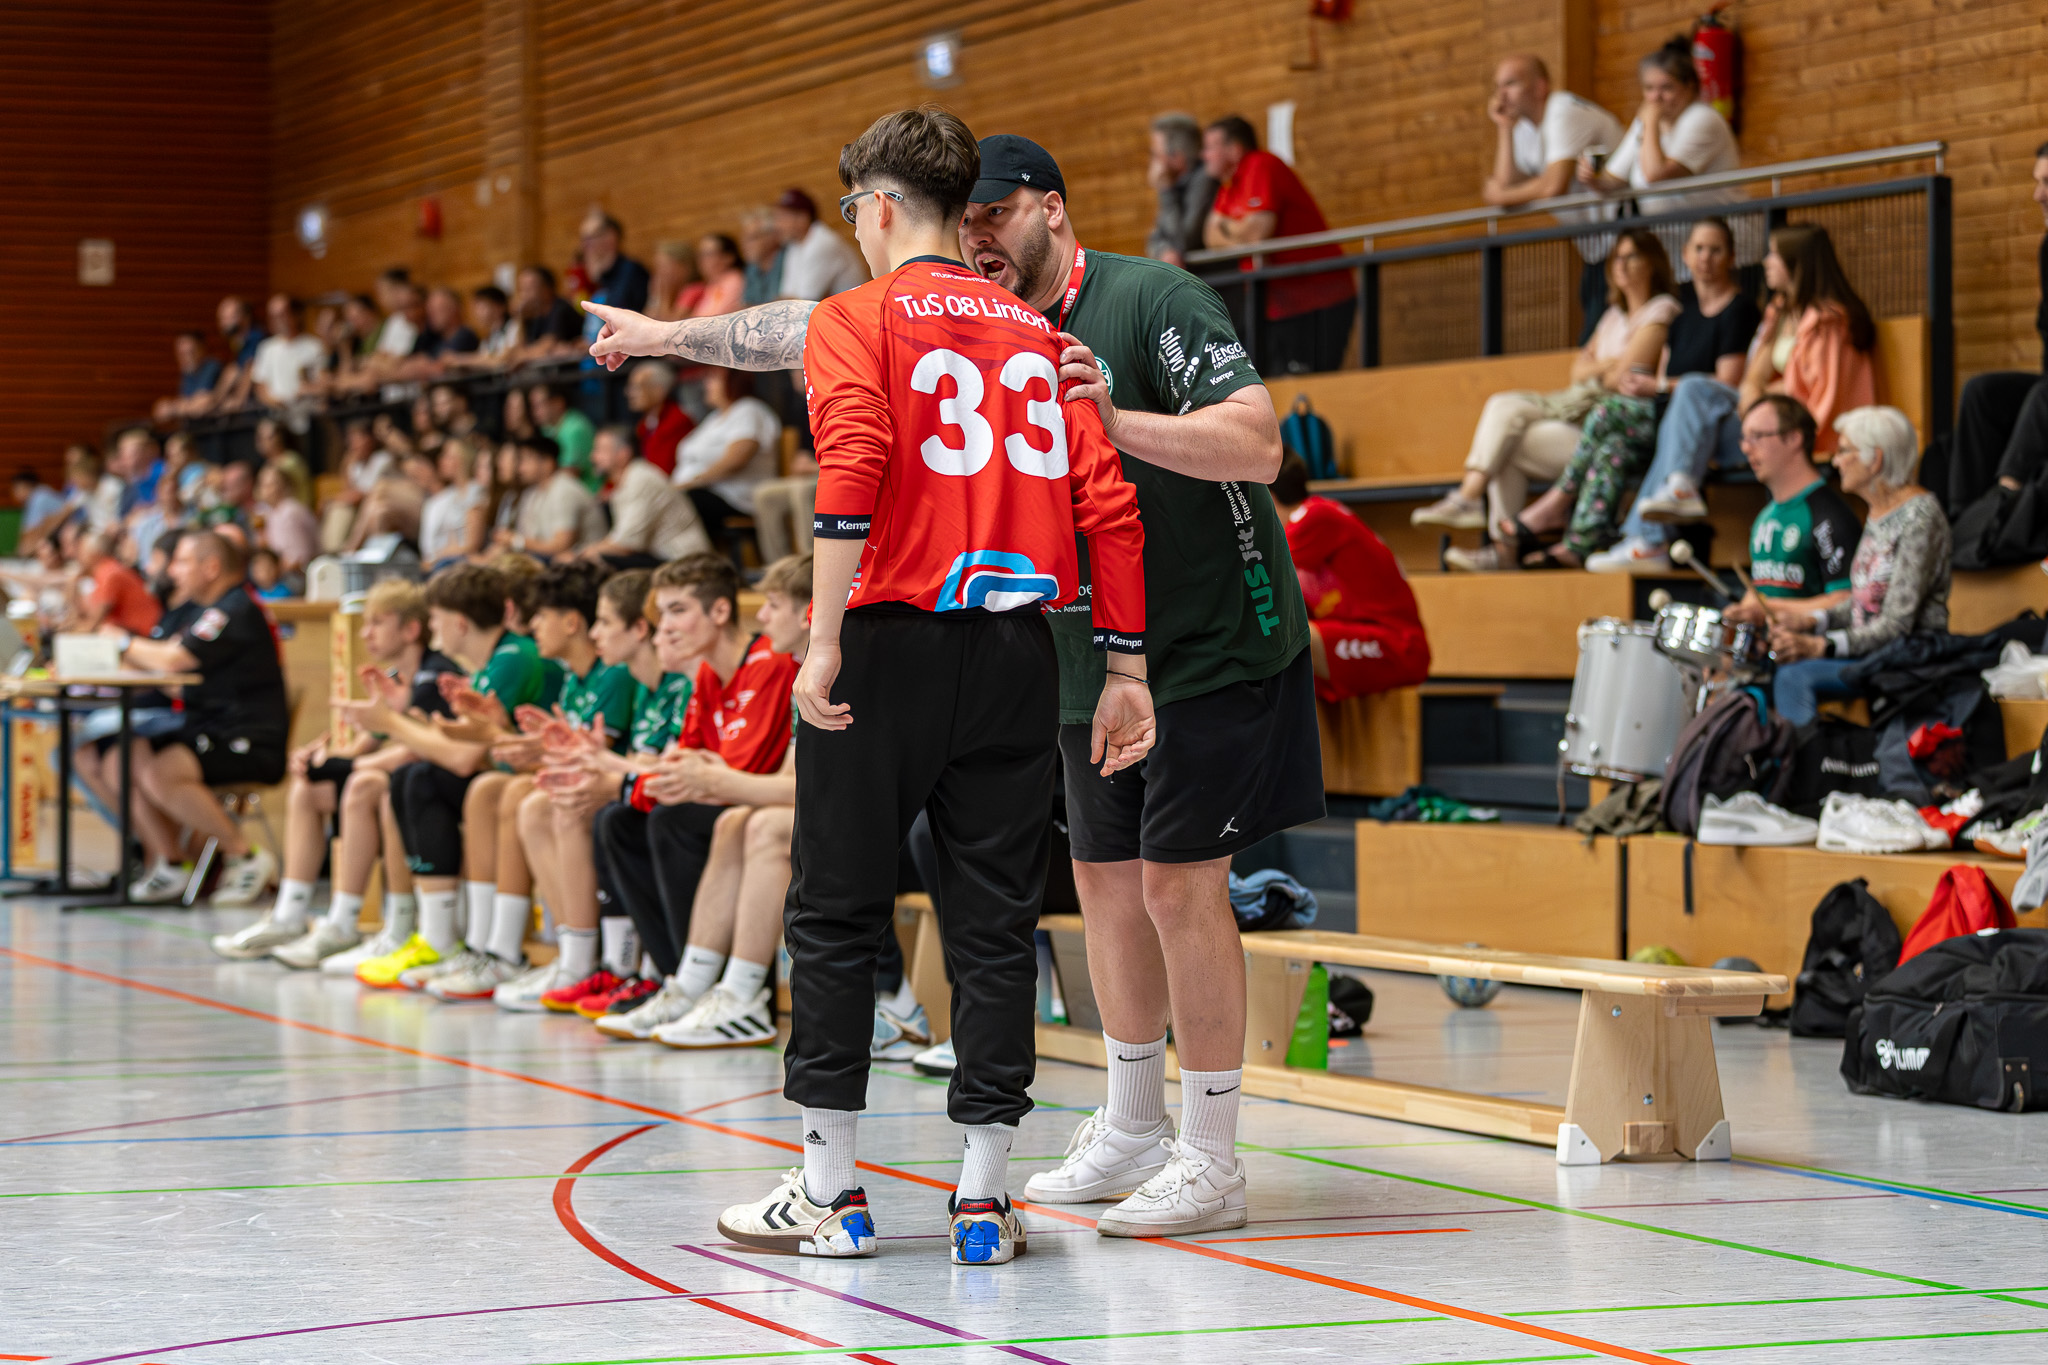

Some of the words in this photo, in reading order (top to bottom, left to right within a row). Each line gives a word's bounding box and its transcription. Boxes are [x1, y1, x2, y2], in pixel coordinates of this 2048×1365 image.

[894, 293, 945, 319] TuS
[945, 295, 979, 318] 08
[1062, 287, 1078, 315] REWE
[1159, 326, 1186, 372] bluvo
[1209, 370, 1235, 386] Kempa
[910, 348, 1070, 480] 33
[1226, 489, 1245, 527] Zentrum
[1235, 491, 1253, 522] Fitness
[837, 520, 871, 532] Kempa
[1063, 604, 1091, 613] Andreas
[1108, 634, 1143, 649] Kempa
[960, 1201, 994, 1210] hummel
